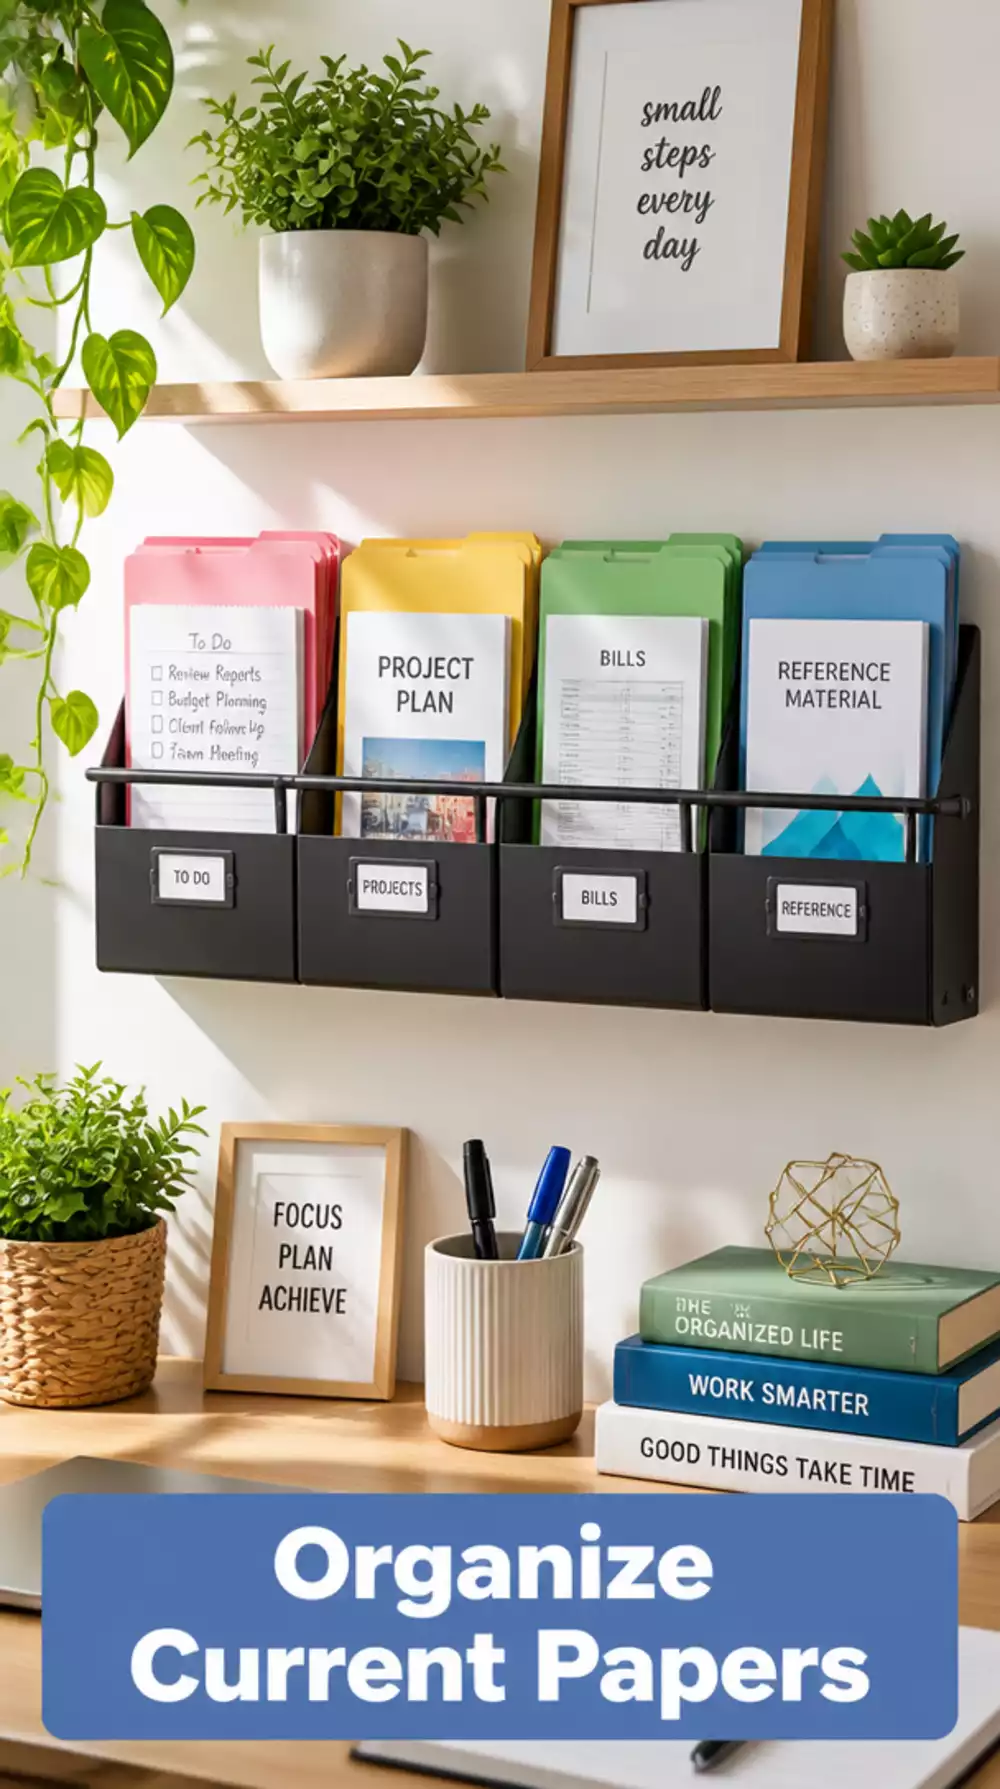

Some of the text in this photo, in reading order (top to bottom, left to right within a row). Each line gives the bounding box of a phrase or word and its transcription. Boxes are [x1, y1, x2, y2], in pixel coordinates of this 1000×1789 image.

[640, 85, 723, 128] small
[640, 136, 716, 179] steps
[636, 189, 715, 224] every
[642, 225, 702, 272] day
[188, 632, 232, 650] To Do
[378, 655, 474, 680] PROJECT
[600, 650, 646, 667] BILLS
[778, 661, 891, 682] REFERENCE
[168, 690, 210, 713] Budget
[396, 690, 453, 714] PLAN
[785, 689, 882, 709] MATERIAL
[174, 869, 210, 885] TO DO
[362, 879, 423, 897] PROJECTS
[581, 889, 618, 906] BILLS
[781, 900, 852, 919] REFERENCE
[273, 1201, 343, 1230] FOCUS
[278, 1243, 333, 1271] PLAN
[258, 1284, 347, 1315] ACHIEVE
[675, 1316, 843, 1352] ORGANIZED LIFE
[688, 1374, 869, 1416] WORK SMARTER
[640, 1437, 915, 1493] GOOD THINGS TAKE TIME
